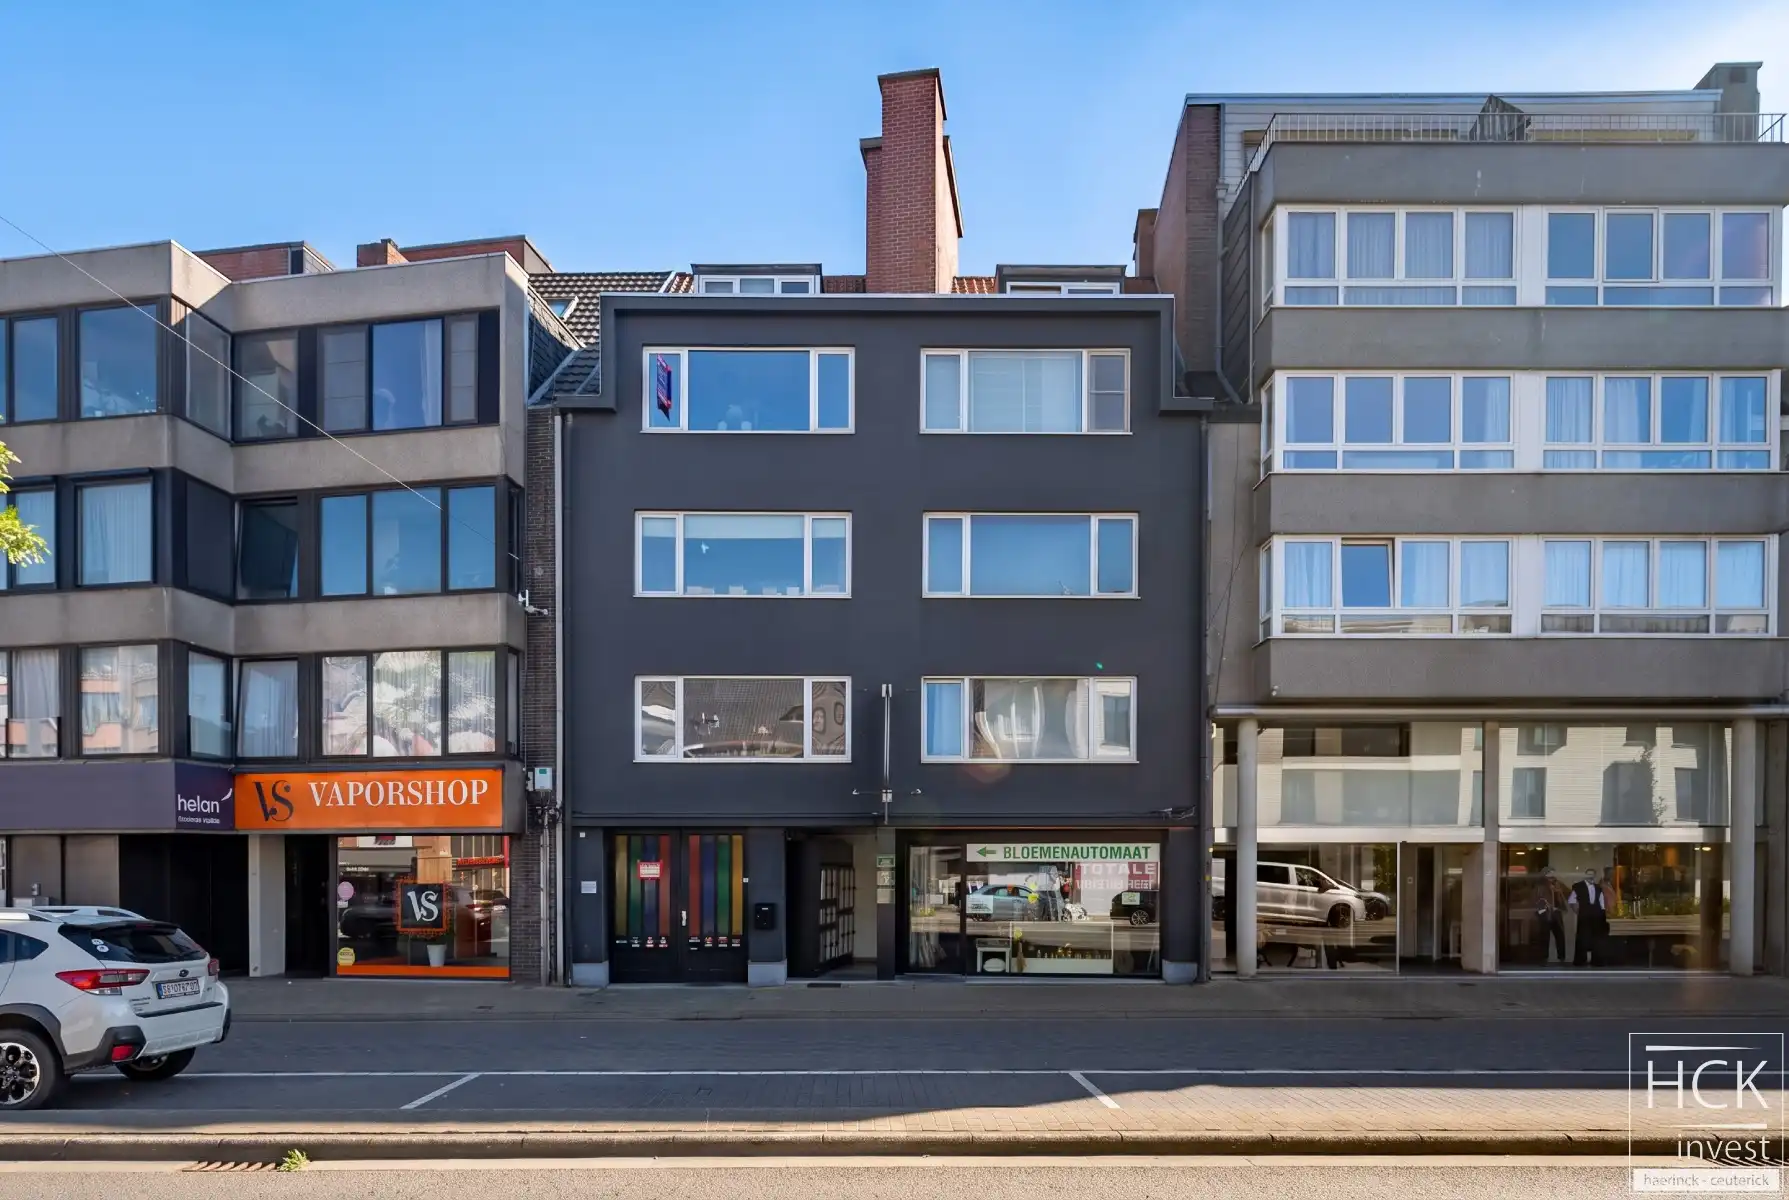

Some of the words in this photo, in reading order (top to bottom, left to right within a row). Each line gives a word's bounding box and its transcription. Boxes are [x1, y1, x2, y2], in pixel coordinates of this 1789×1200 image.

[177, 794, 220, 814] helan
[253, 780, 294, 822] VS
[307, 779, 489, 807] VAPORSHOP
[1003, 845, 1152, 860] BLOEMENAUTOMAAT
[1080, 863, 1157, 875] TOTALE
[406, 890, 439, 922] VS
